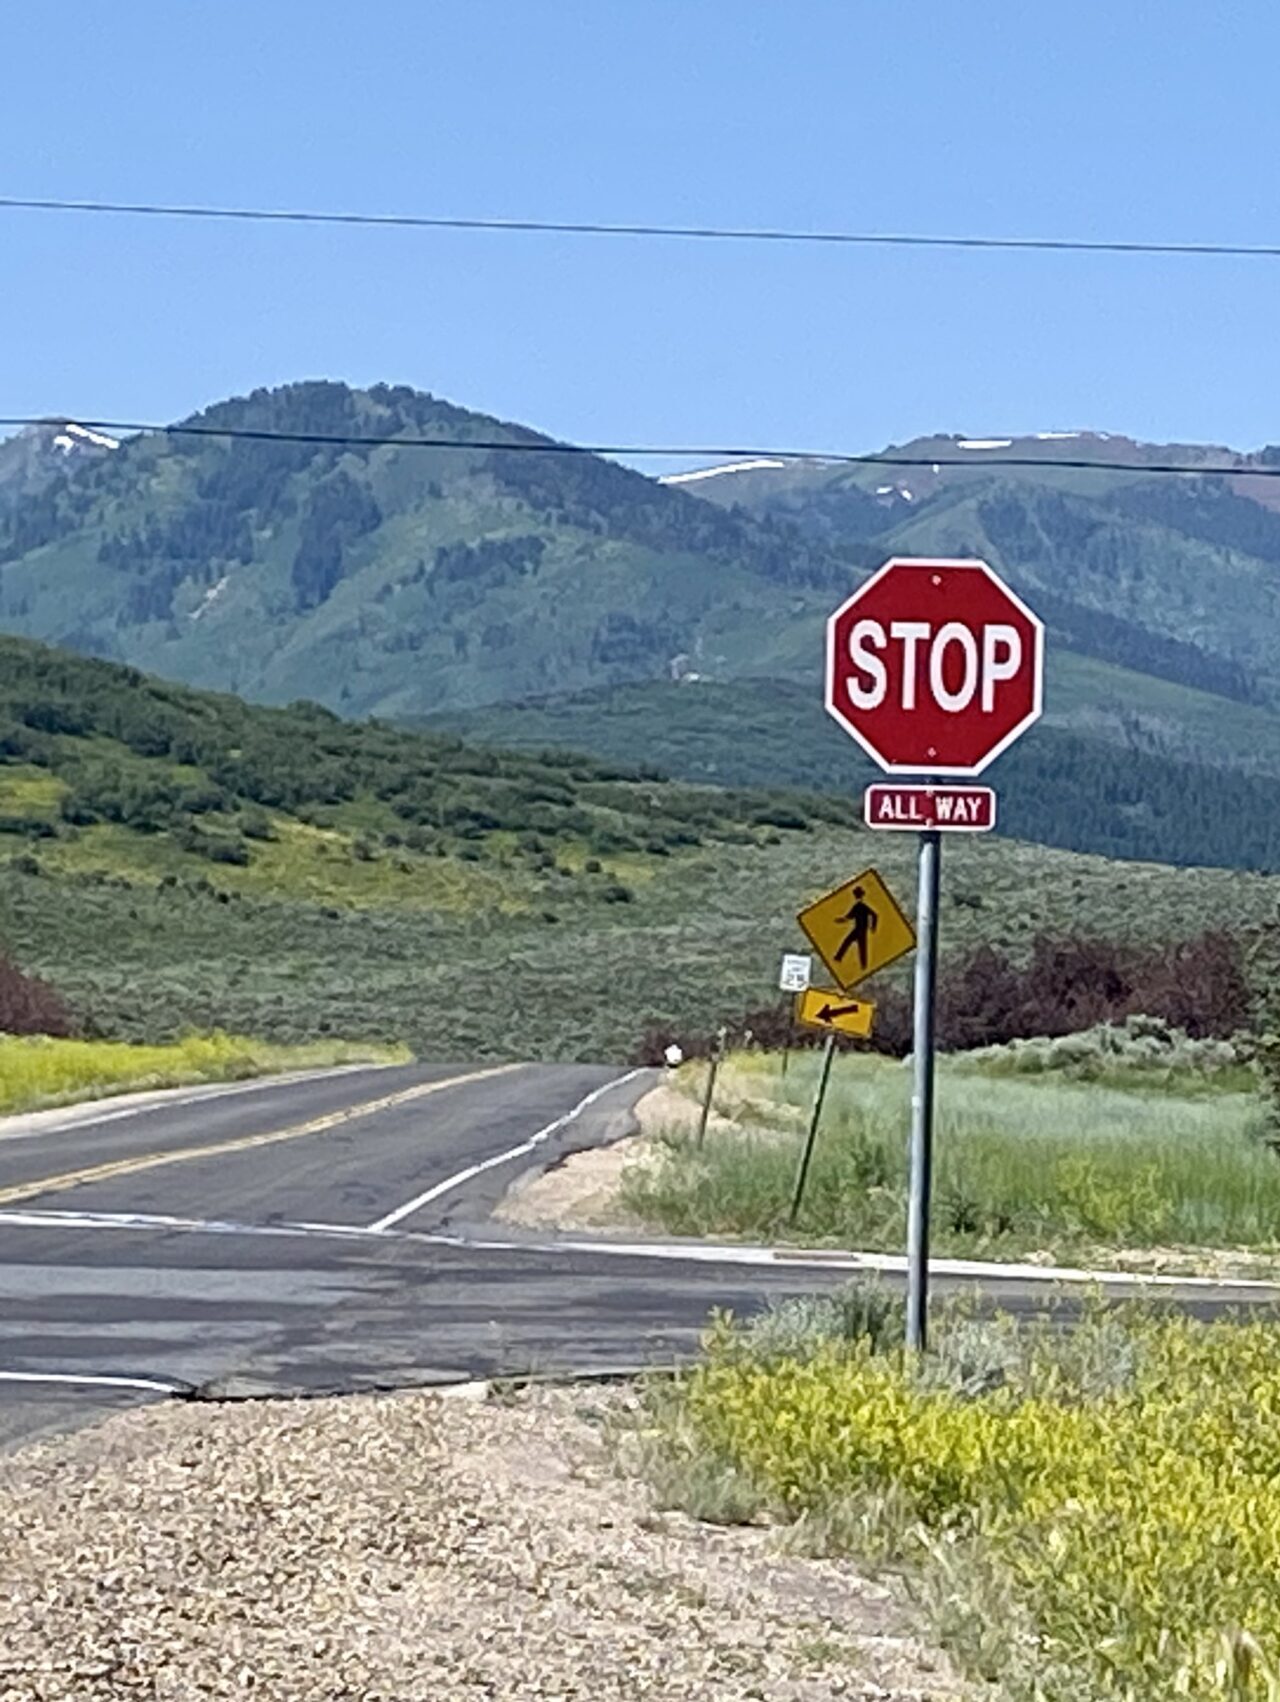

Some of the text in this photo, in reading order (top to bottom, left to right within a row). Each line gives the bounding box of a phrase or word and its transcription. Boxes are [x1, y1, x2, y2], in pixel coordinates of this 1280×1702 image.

[846, 619, 1022, 713] STOP
[878, 795, 982, 822] ALL WAY
